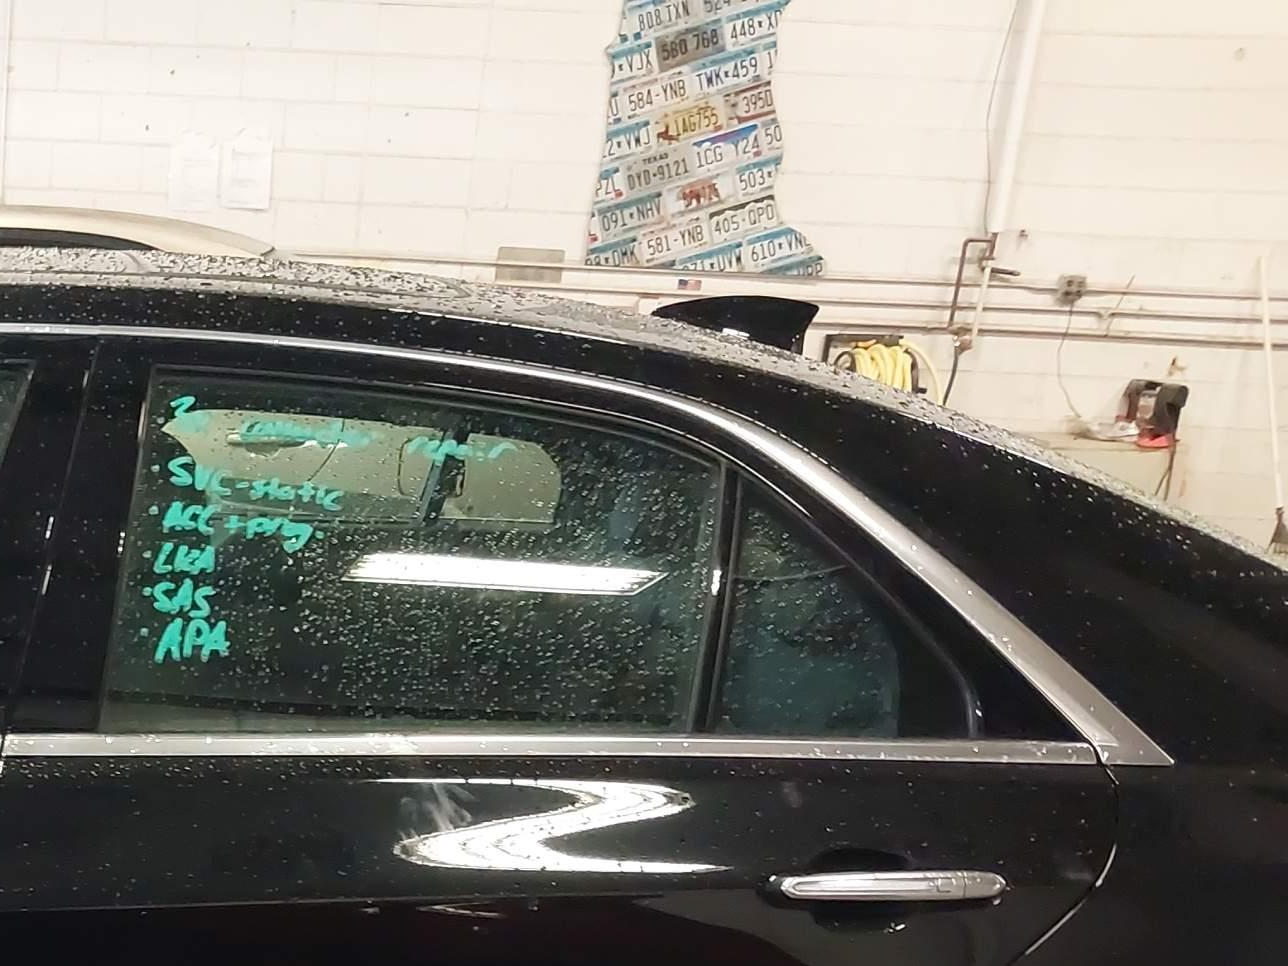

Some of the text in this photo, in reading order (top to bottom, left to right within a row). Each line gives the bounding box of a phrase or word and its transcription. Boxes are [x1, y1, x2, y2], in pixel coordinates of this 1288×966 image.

[730, 18, 756, 39] 448
[732, 56, 759, 79] 459
[739, 169, 766, 191] 503
[601, 208, 627, 232] 091
[751, 241, 776, 262] 610
[153, 578, 216, 618] SAS
